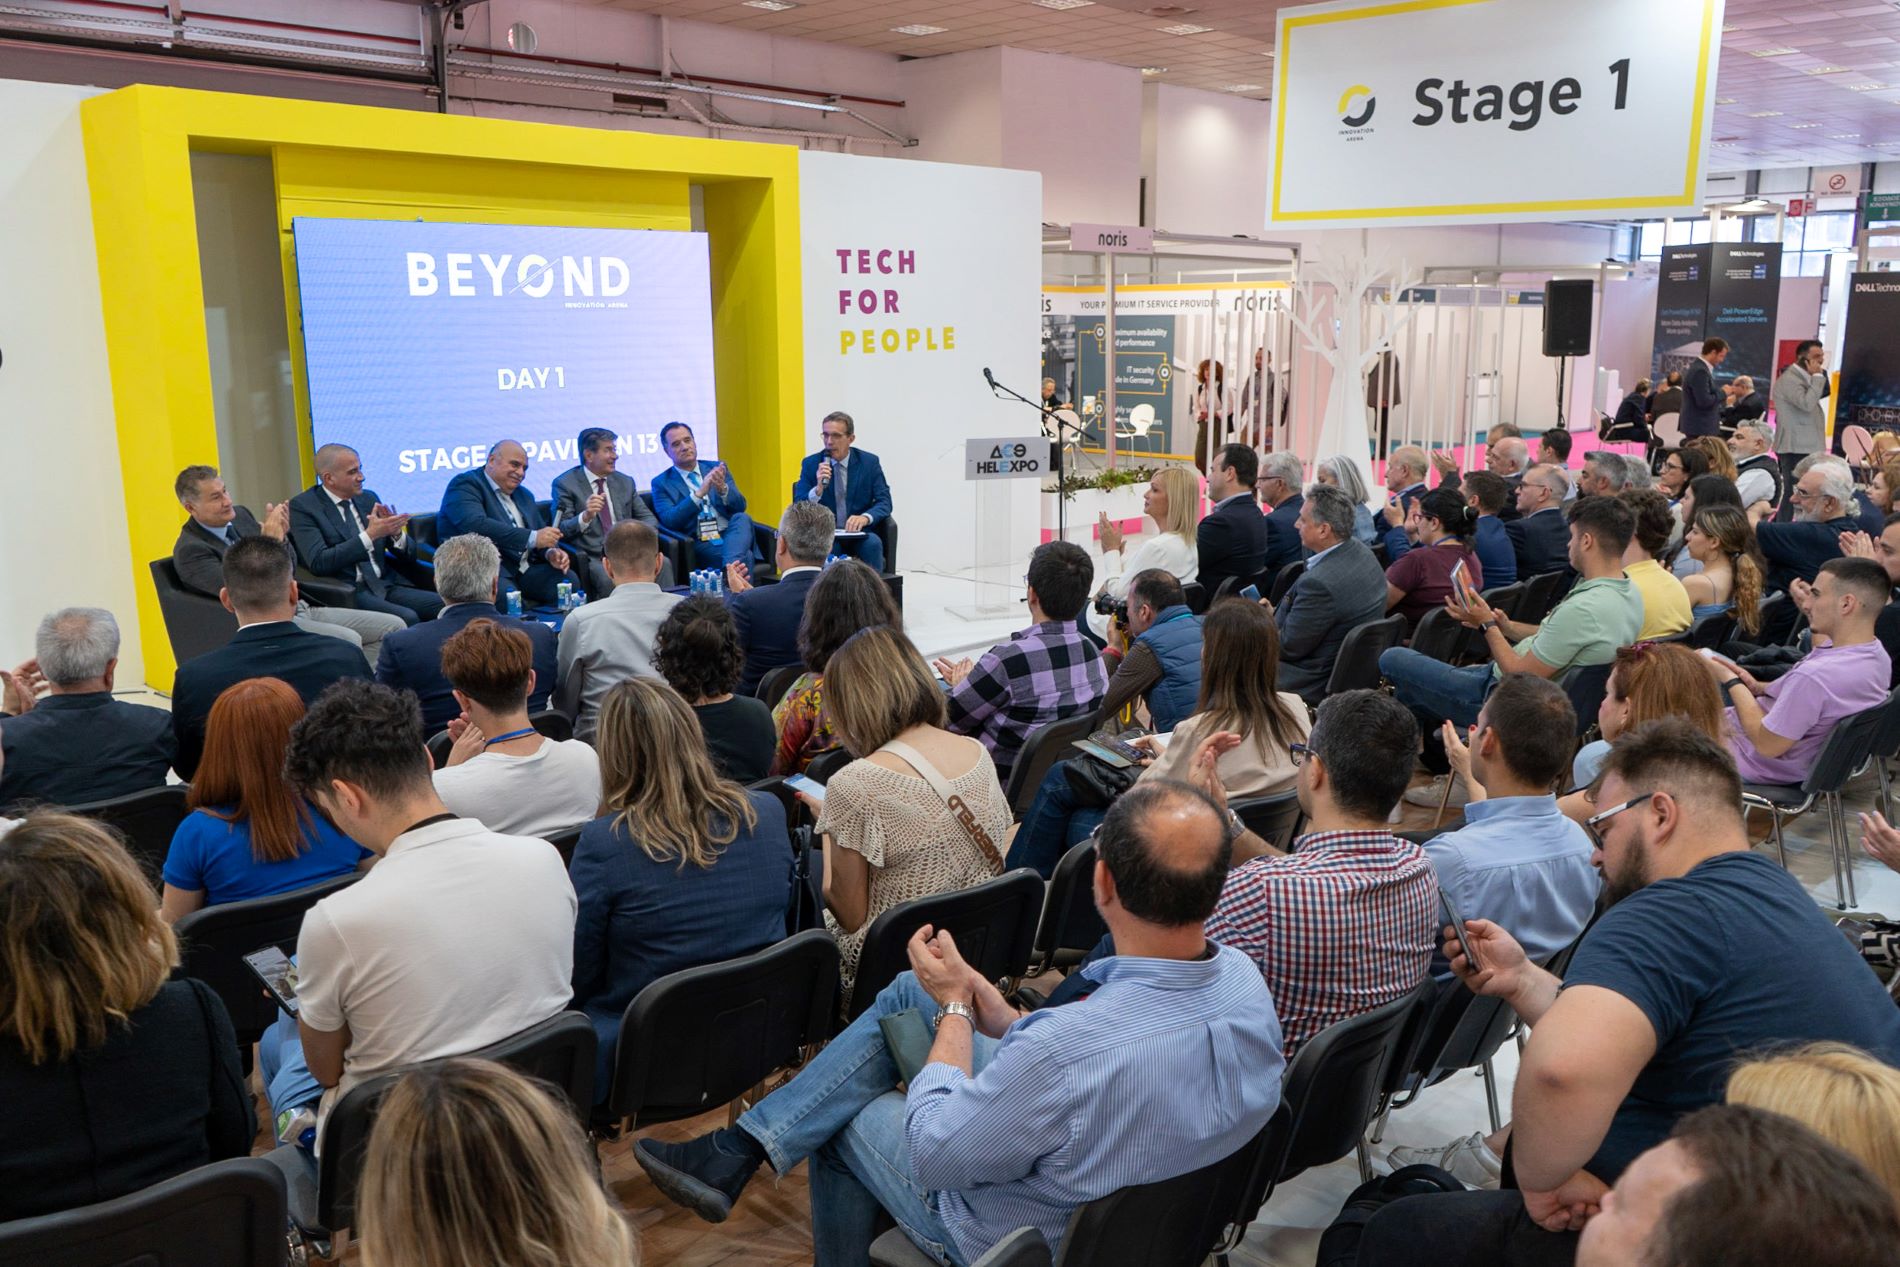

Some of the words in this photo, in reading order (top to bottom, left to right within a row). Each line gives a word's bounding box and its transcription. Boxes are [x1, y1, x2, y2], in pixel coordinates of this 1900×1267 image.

[1412, 77, 1582, 131] Stage
[1608, 58, 1631, 110] 1
[1805, 202, 1814, 213] F
[1098, 230, 1128, 247] noris
[836, 249, 915, 274] TECH
[406, 252, 630, 298] BEYOND
[839, 289, 900, 314] FOR
[1080, 301, 1100, 310] YOUR
[1101, 300, 1136, 310] PMIUM
[1137, 300, 1145, 309] IT
[1147, 299, 1178, 309] SERVICE
[840, 326, 955, 355] PEOPLE
[1137, 328, 1167, 338] availability
[1120, 338, 1156, 347] performance
[497, 367, 550, 390] DAY
[555, 366, 566, 388] 1
[1133, 366, 1154, 376] security
[1130, 376, 1155, 386] Germany
[398, 444, 487, 473] STAGE
[523, 434, 633, 462] PAVIN
[636, 432, 659, 455] 13
[976, 459, 1039, 474] HELEXPO
